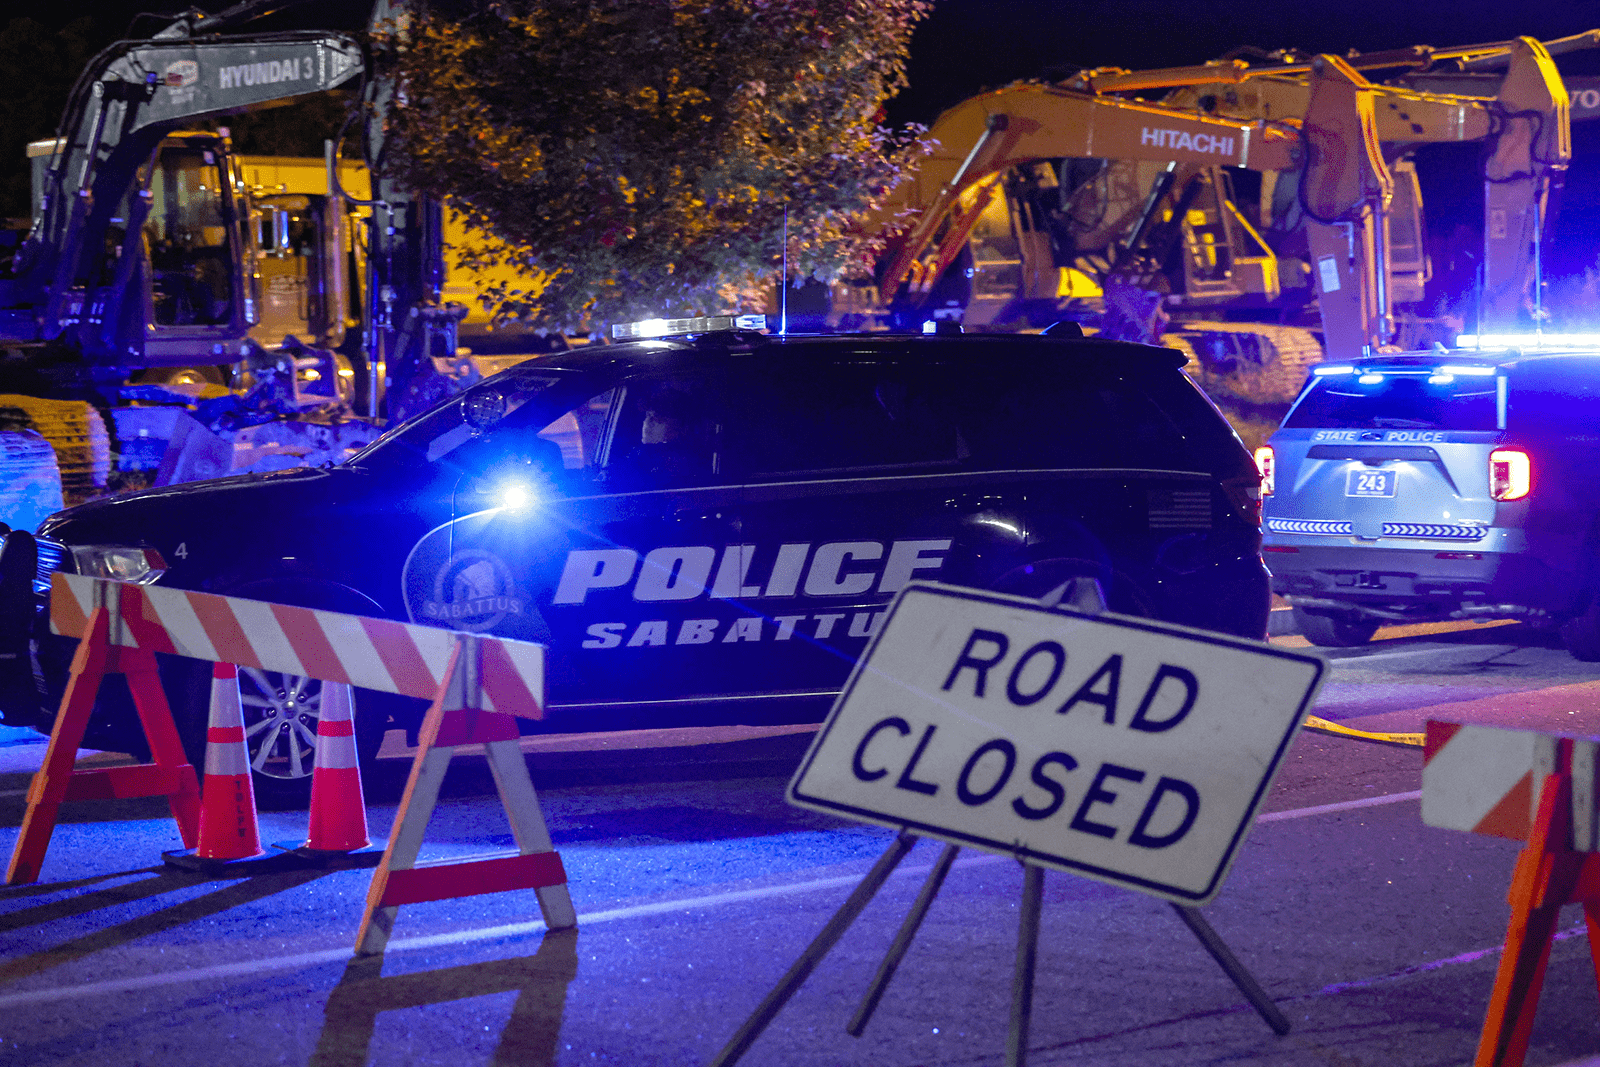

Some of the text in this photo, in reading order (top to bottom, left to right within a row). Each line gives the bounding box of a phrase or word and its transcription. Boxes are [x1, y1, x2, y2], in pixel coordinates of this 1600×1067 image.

[219, 56, 314, 89] HYUNDAI 3
[1141, 127, 1234, 156] HITACHI
[1315, 430, 1443, 442] STATE POLICE
[1357, 474, 1386, 491] 243
[174, 541, 189, 560] 4
[553, 539, 953, 604] POLICE
[427, 598, 520, 618] SABATTUS
[941, 628, 1200, 734] ROAD
[851, 716, 1201, 849] CLOSED
